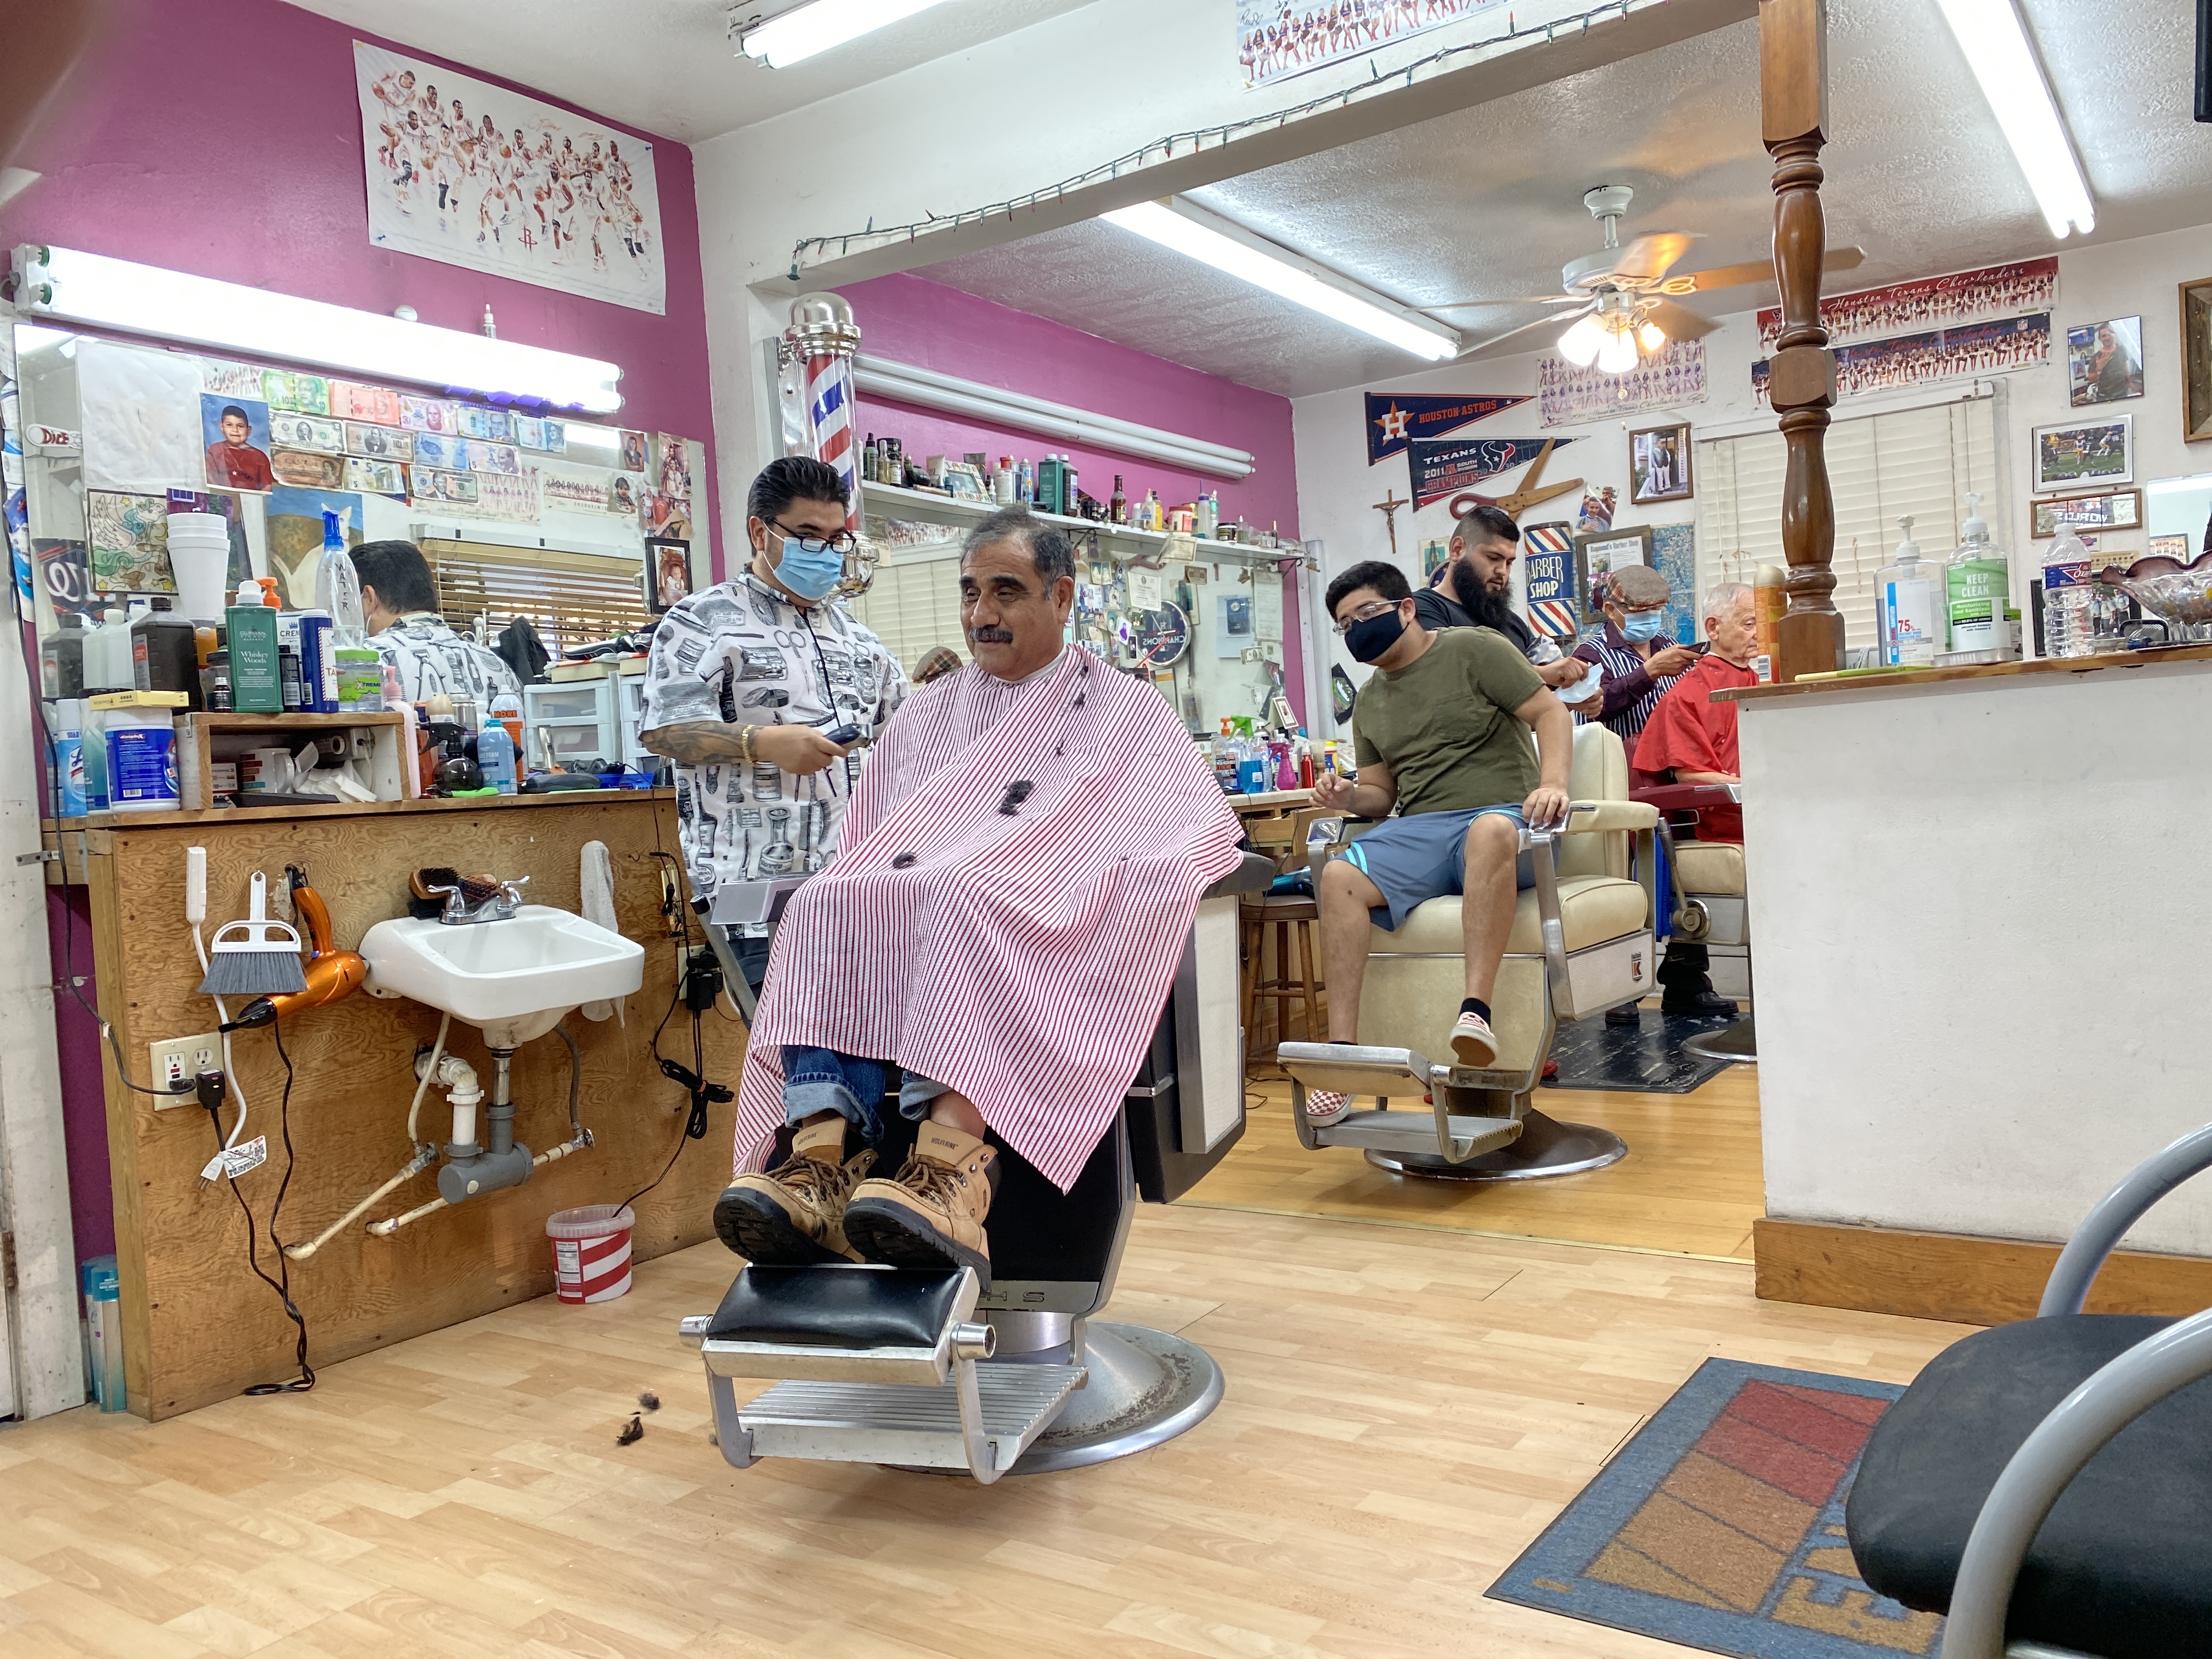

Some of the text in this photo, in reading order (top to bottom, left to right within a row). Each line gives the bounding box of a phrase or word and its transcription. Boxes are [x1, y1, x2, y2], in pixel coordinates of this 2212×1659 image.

[1828, 265, 2025, 311] Houston Texans Cheerleaders
[1419, 399, 1497, 424] HOUSTON ASTROS
[1639, 397, 1680, 409] Cheerleaders
[1423, 447, 1477, 465] TEXANS
[366, 462, 372, 472] 5
[1424, 466, 1444, 479] 2011
[1457, 459, 1477, 467] SOUTH
[1526, 556, 1564, 588] BARBER
[1966, 573, 1989, 586] KEEP
[1530, 580, 1559, 599] SHOP
[1961, 585, 1989, 598] CLEAN
[930, 1137, 957, 1150] WOLVERINE
